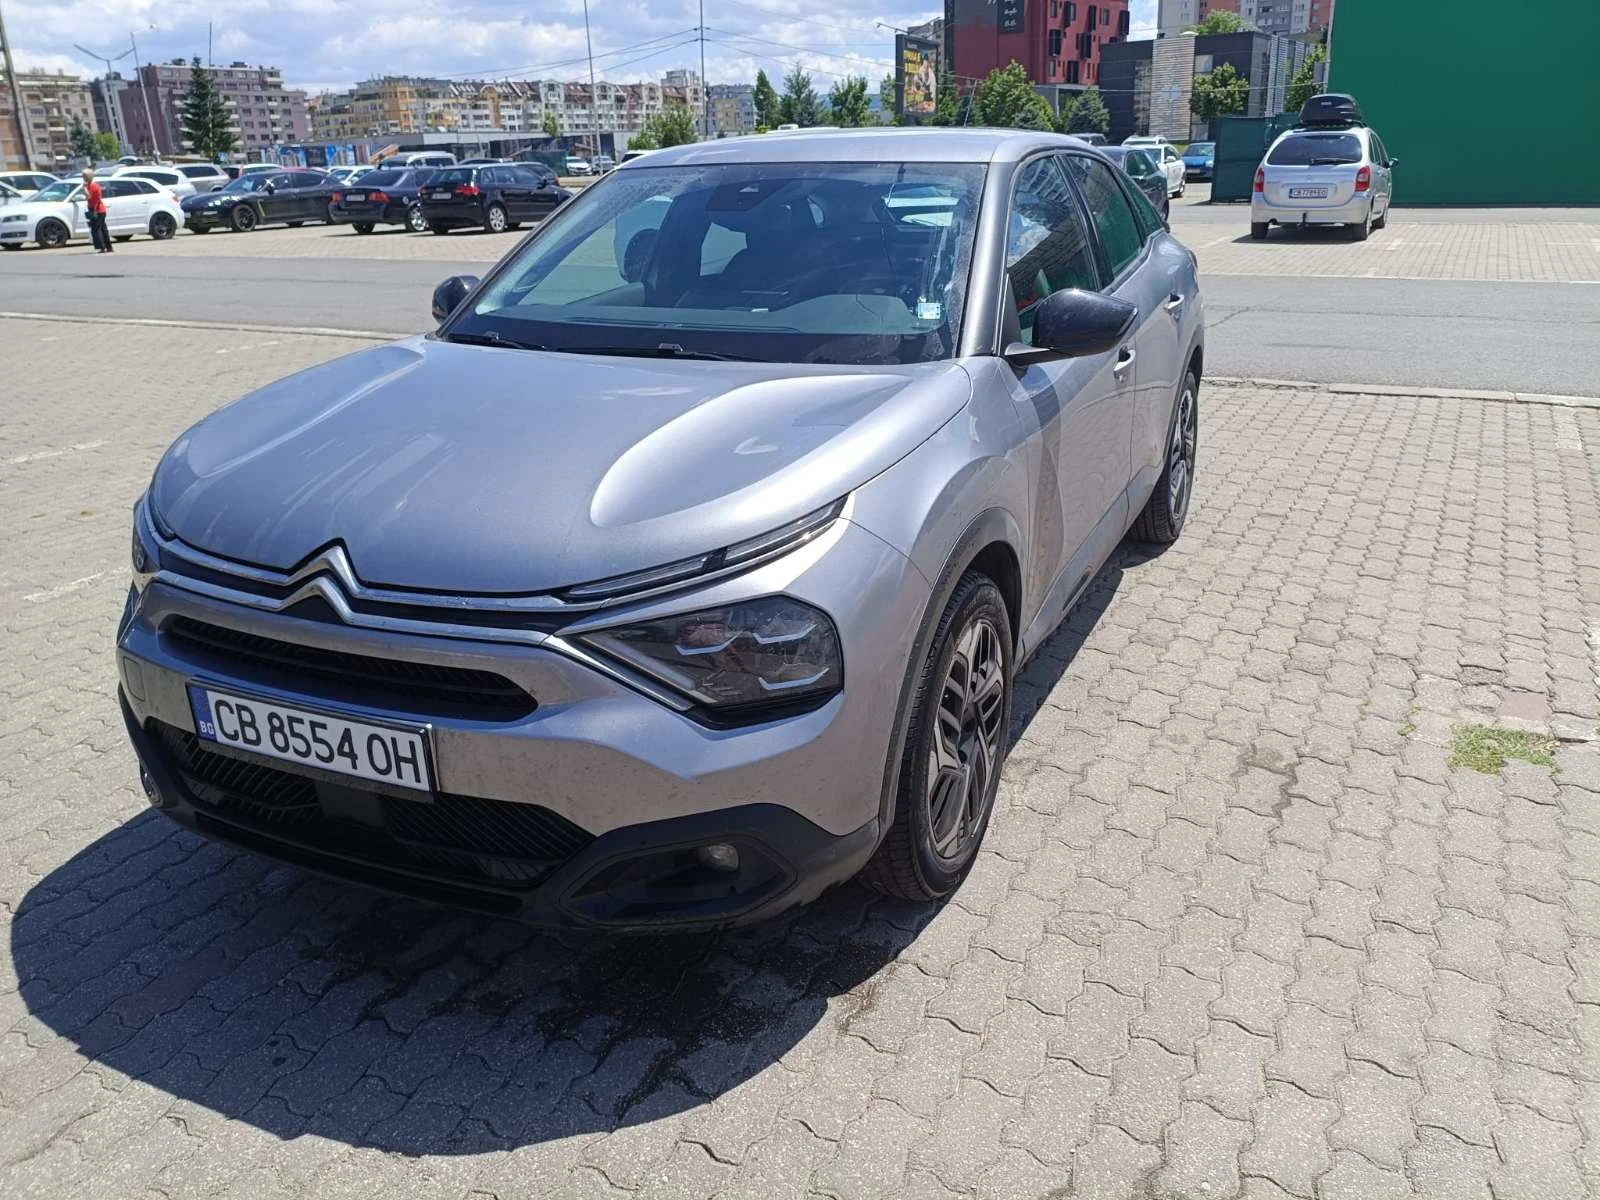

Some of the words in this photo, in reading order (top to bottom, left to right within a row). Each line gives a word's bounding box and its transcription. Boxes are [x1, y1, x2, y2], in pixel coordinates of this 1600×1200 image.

[200, 720, 214, 735] BG
[214, 699, 262, 746] CB
[267, 711, 359, 770] 8554
[366, 733, 422, 783] OH
